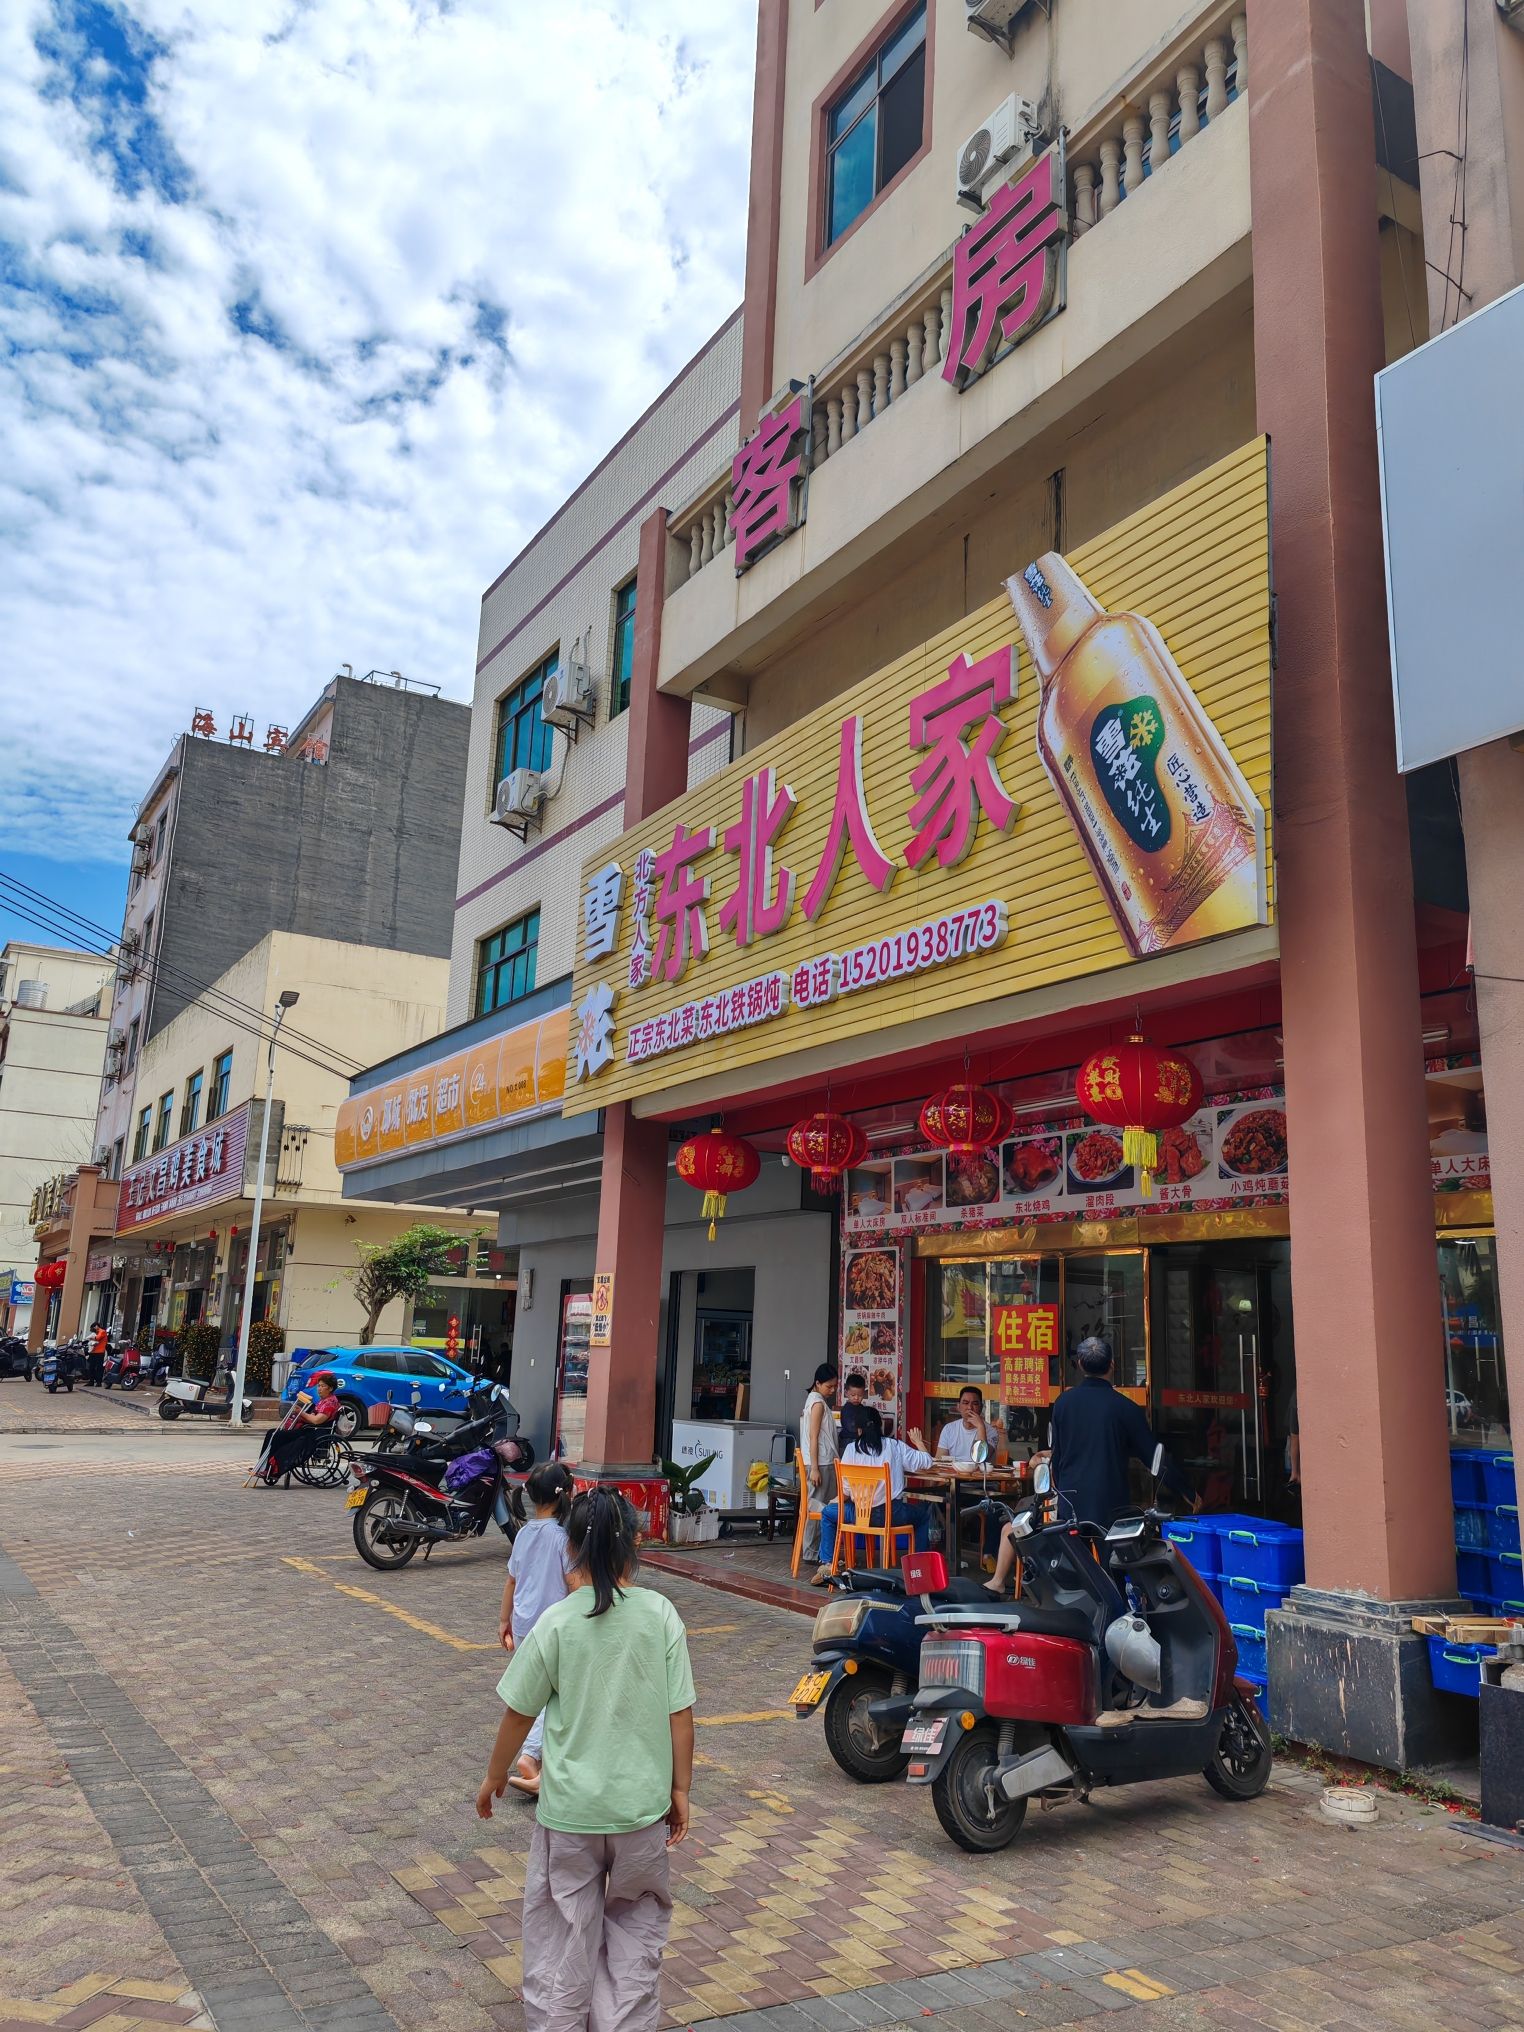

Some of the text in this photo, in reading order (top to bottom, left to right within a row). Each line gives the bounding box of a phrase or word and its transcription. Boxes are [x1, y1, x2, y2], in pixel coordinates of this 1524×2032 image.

[1166, 752, 1212, 824] 匠心营造
[651, 642, 1021, 982] 东北人家
[630, 852, 650, 984] 北方人家
[838, 904, 998, 989] 15201938773
[1160, 1187, 1192, 1201] 酱大骨
[960, 1206, 985, 1219] 杀猪菜
[1015, 1200, 1051, 1214] 东北烧鸡
[900, 1211, 937, 1225] 双人标准间
[997, 1308, 1054, 1351] 住宿
[1004, 1356, 1045, 1373] 高薪聘请
[1005, 1373, 1041, 1385] 服务员两名
